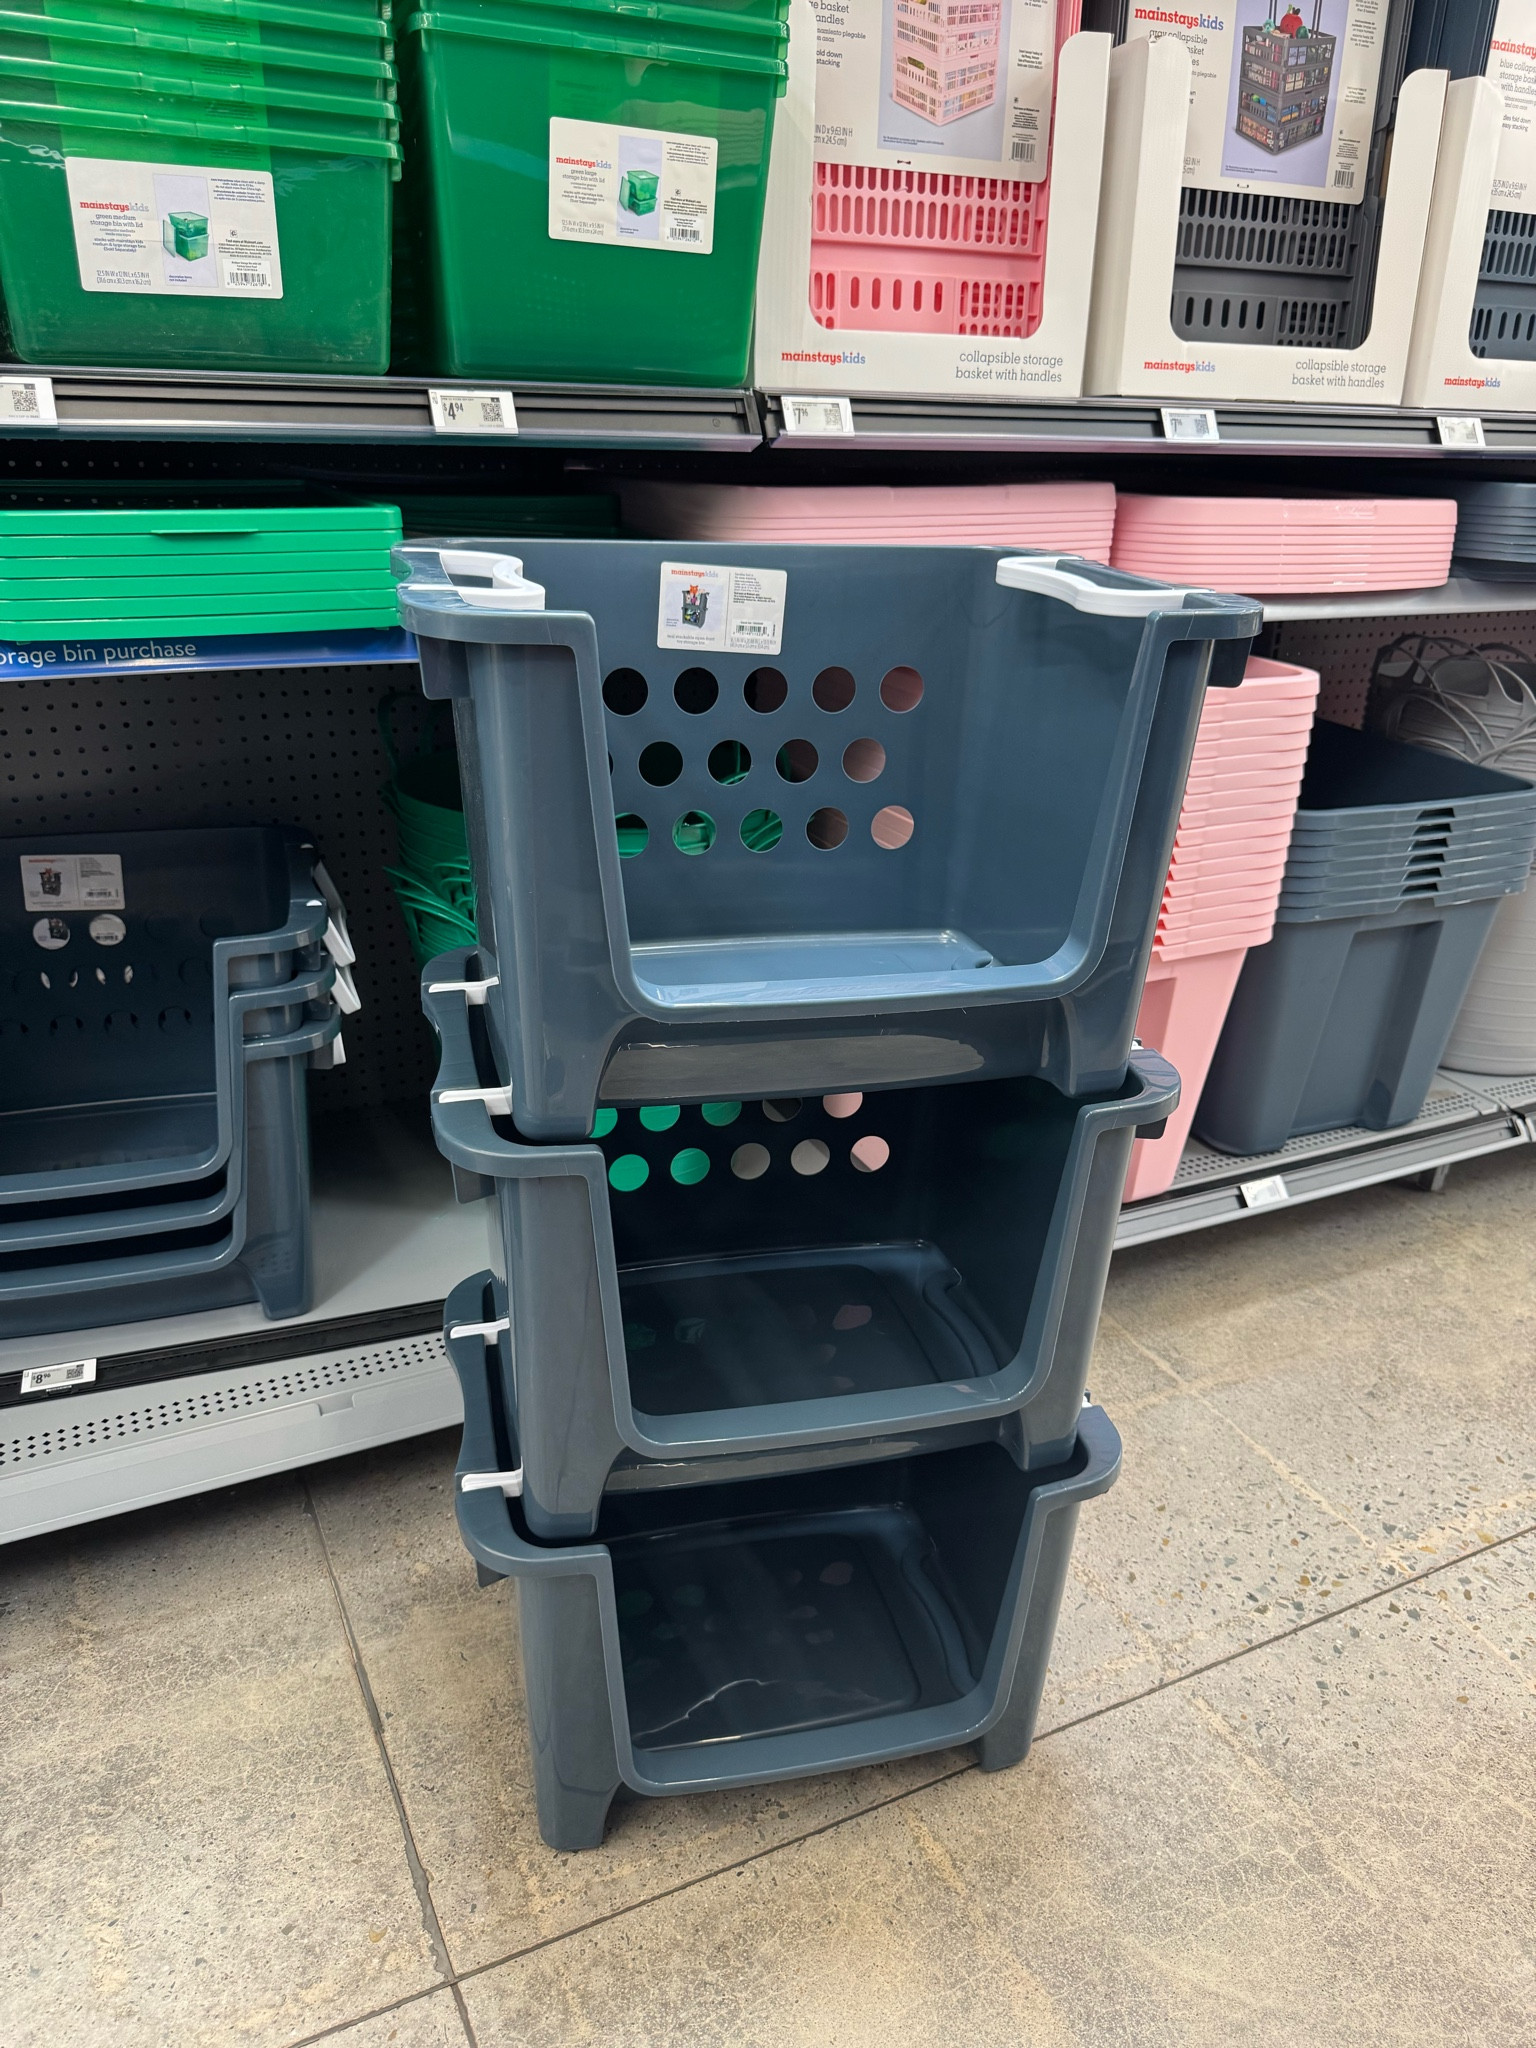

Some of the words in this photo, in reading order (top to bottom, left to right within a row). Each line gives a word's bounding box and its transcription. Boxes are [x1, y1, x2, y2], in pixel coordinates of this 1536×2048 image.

[820, 2, 850, 13] basket
[816, 14, 845, 26] andles
[1135, 7, 1224, 31] mainstayskids
[826, 50, 843, 59] down
[816, 58, 841, 68] stacking
[1500, 58, 1513, 68] blue
[1500, 72, 1522, 83] storage
[1501, 82, 1513, 92] with
[556, 156, 611, 169] mainstayskids
[781, 350, 866, 366] mainstayskids
[960, 351, 1021, 366] collapsible
[1023, 354, 1064, 368] storage
[1144, 359, 1216, 373] mainstayskids
[1296, 360, 1349, 373] collapsible
[1351, 362, 1386, 375] storage
[956, 366, 993, 380] basket
[995, 368, 1018, 381] with
[1020, 369, 1062, 383] handles
[1292, 374, 1325, 387] basket
[1327, 375, 1346, 387] with
[1348, 376, 1385, 389] handles
[1444, 376, 1501, 389] mainstayskids
[63, 644, 97, 662] bin
[104, 640, 197, 665] purchase
